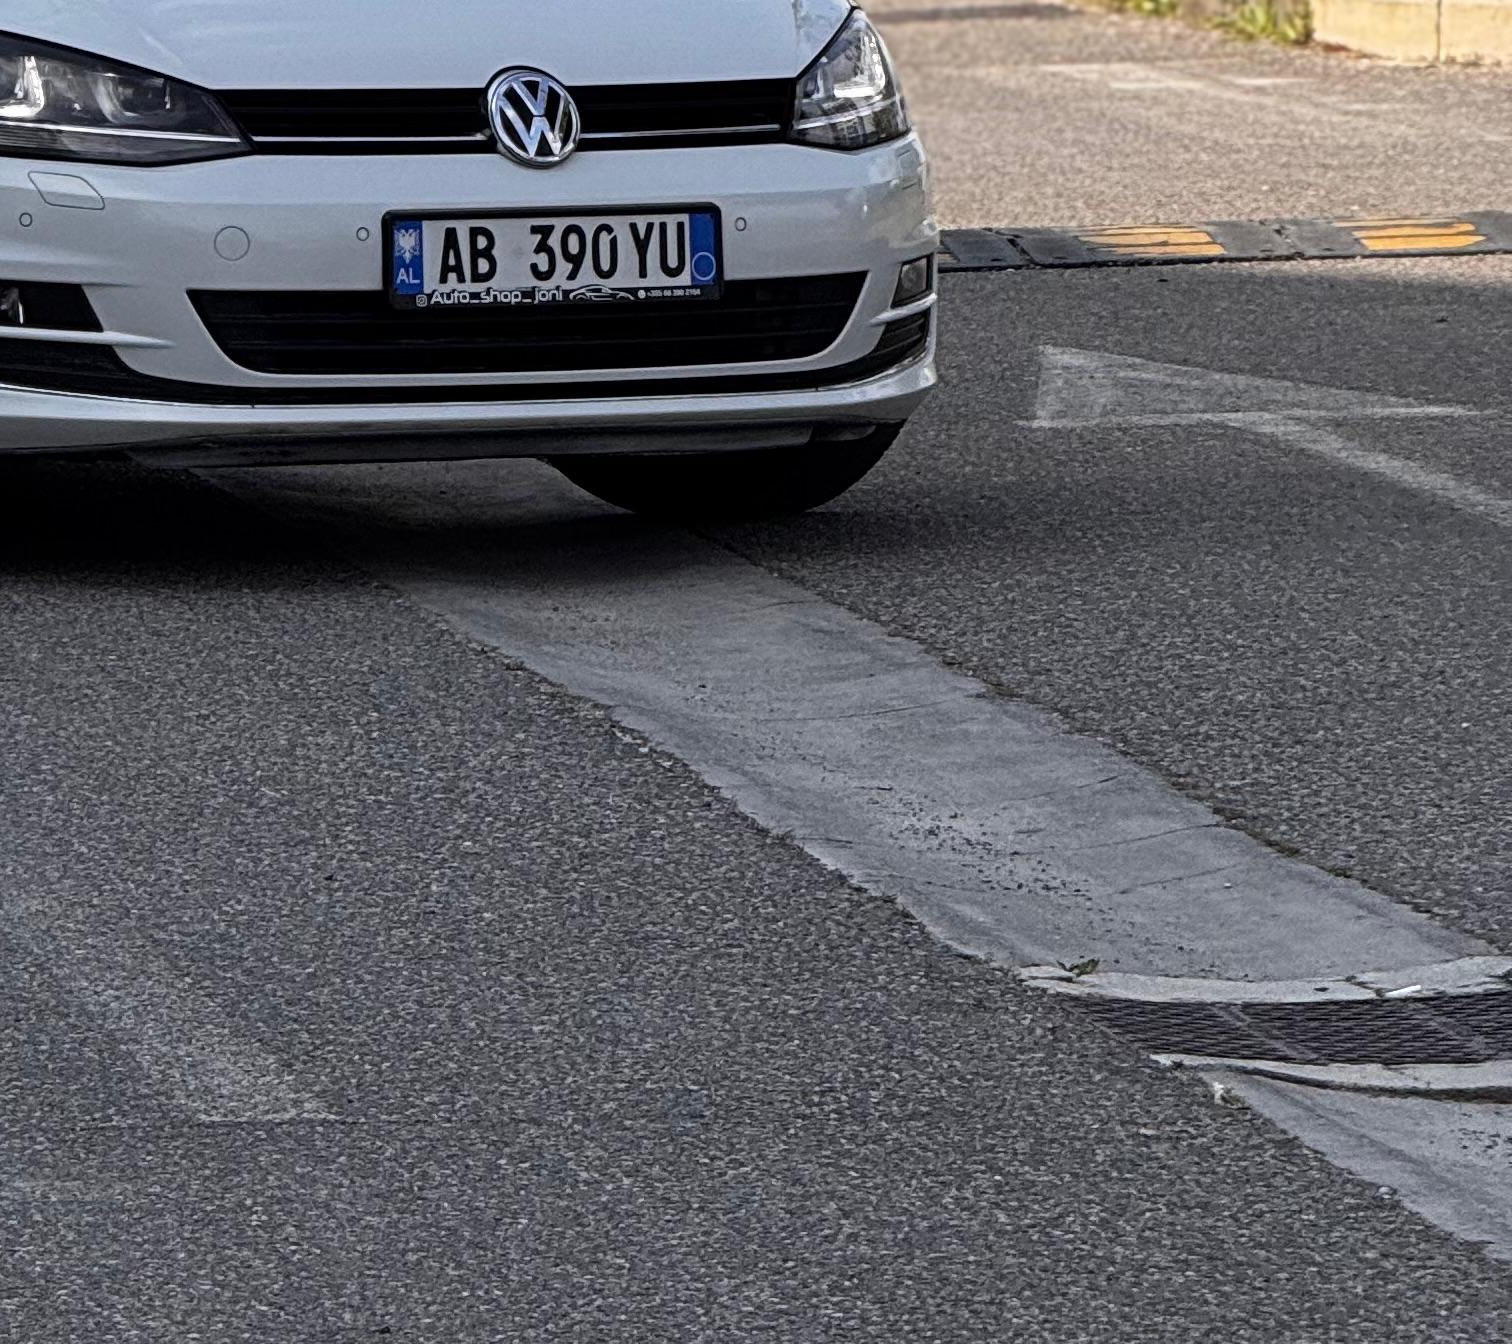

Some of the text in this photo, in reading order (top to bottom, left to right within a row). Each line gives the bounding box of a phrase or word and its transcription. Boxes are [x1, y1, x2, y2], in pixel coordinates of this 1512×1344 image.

[492, 72, 575, 162] VW
[396, 267, 421, 285] AL
[438, 221, 687, 284] AB 390 YU
